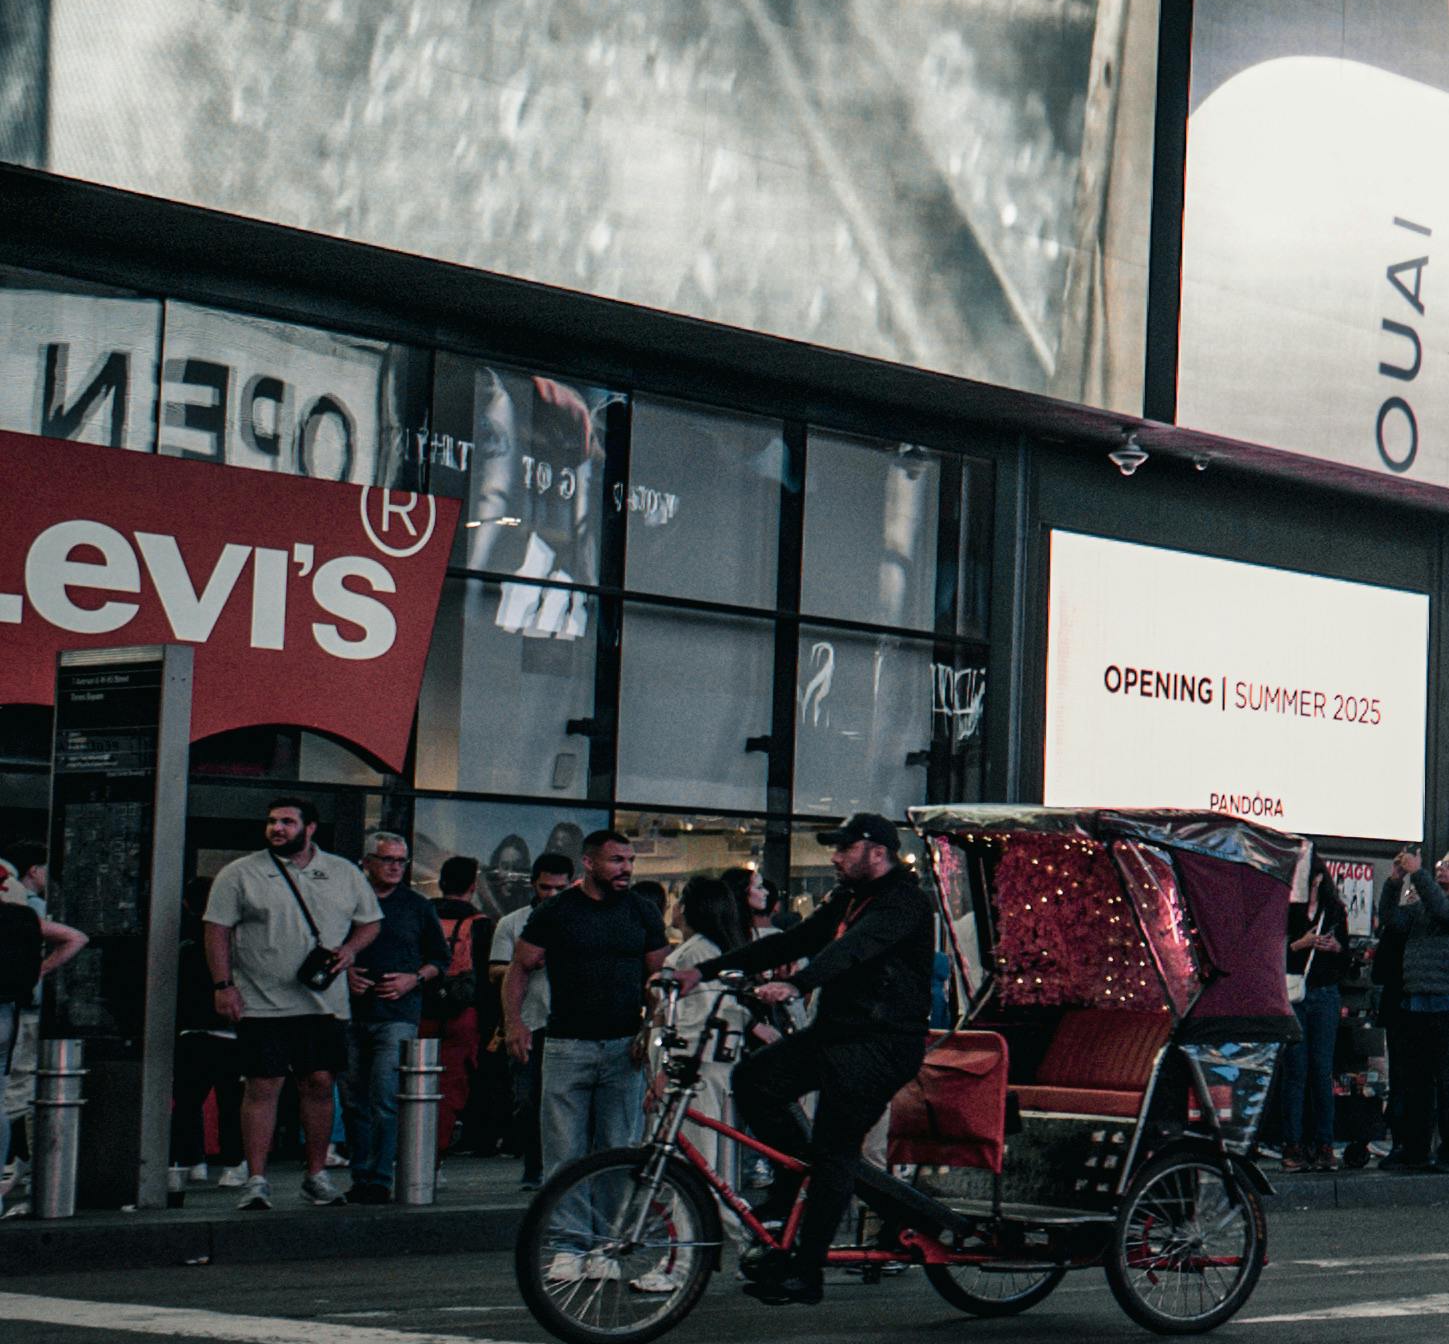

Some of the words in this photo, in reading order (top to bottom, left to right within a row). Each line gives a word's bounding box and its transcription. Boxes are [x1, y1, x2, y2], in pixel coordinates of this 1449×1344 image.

[1375, 216, 1432, 474] OUAI
[1104, 664, 1213, 704] OPENING
[1235, 681, 1326, 719] SUMMER
[1333, 694, 1382, 726] 2025
